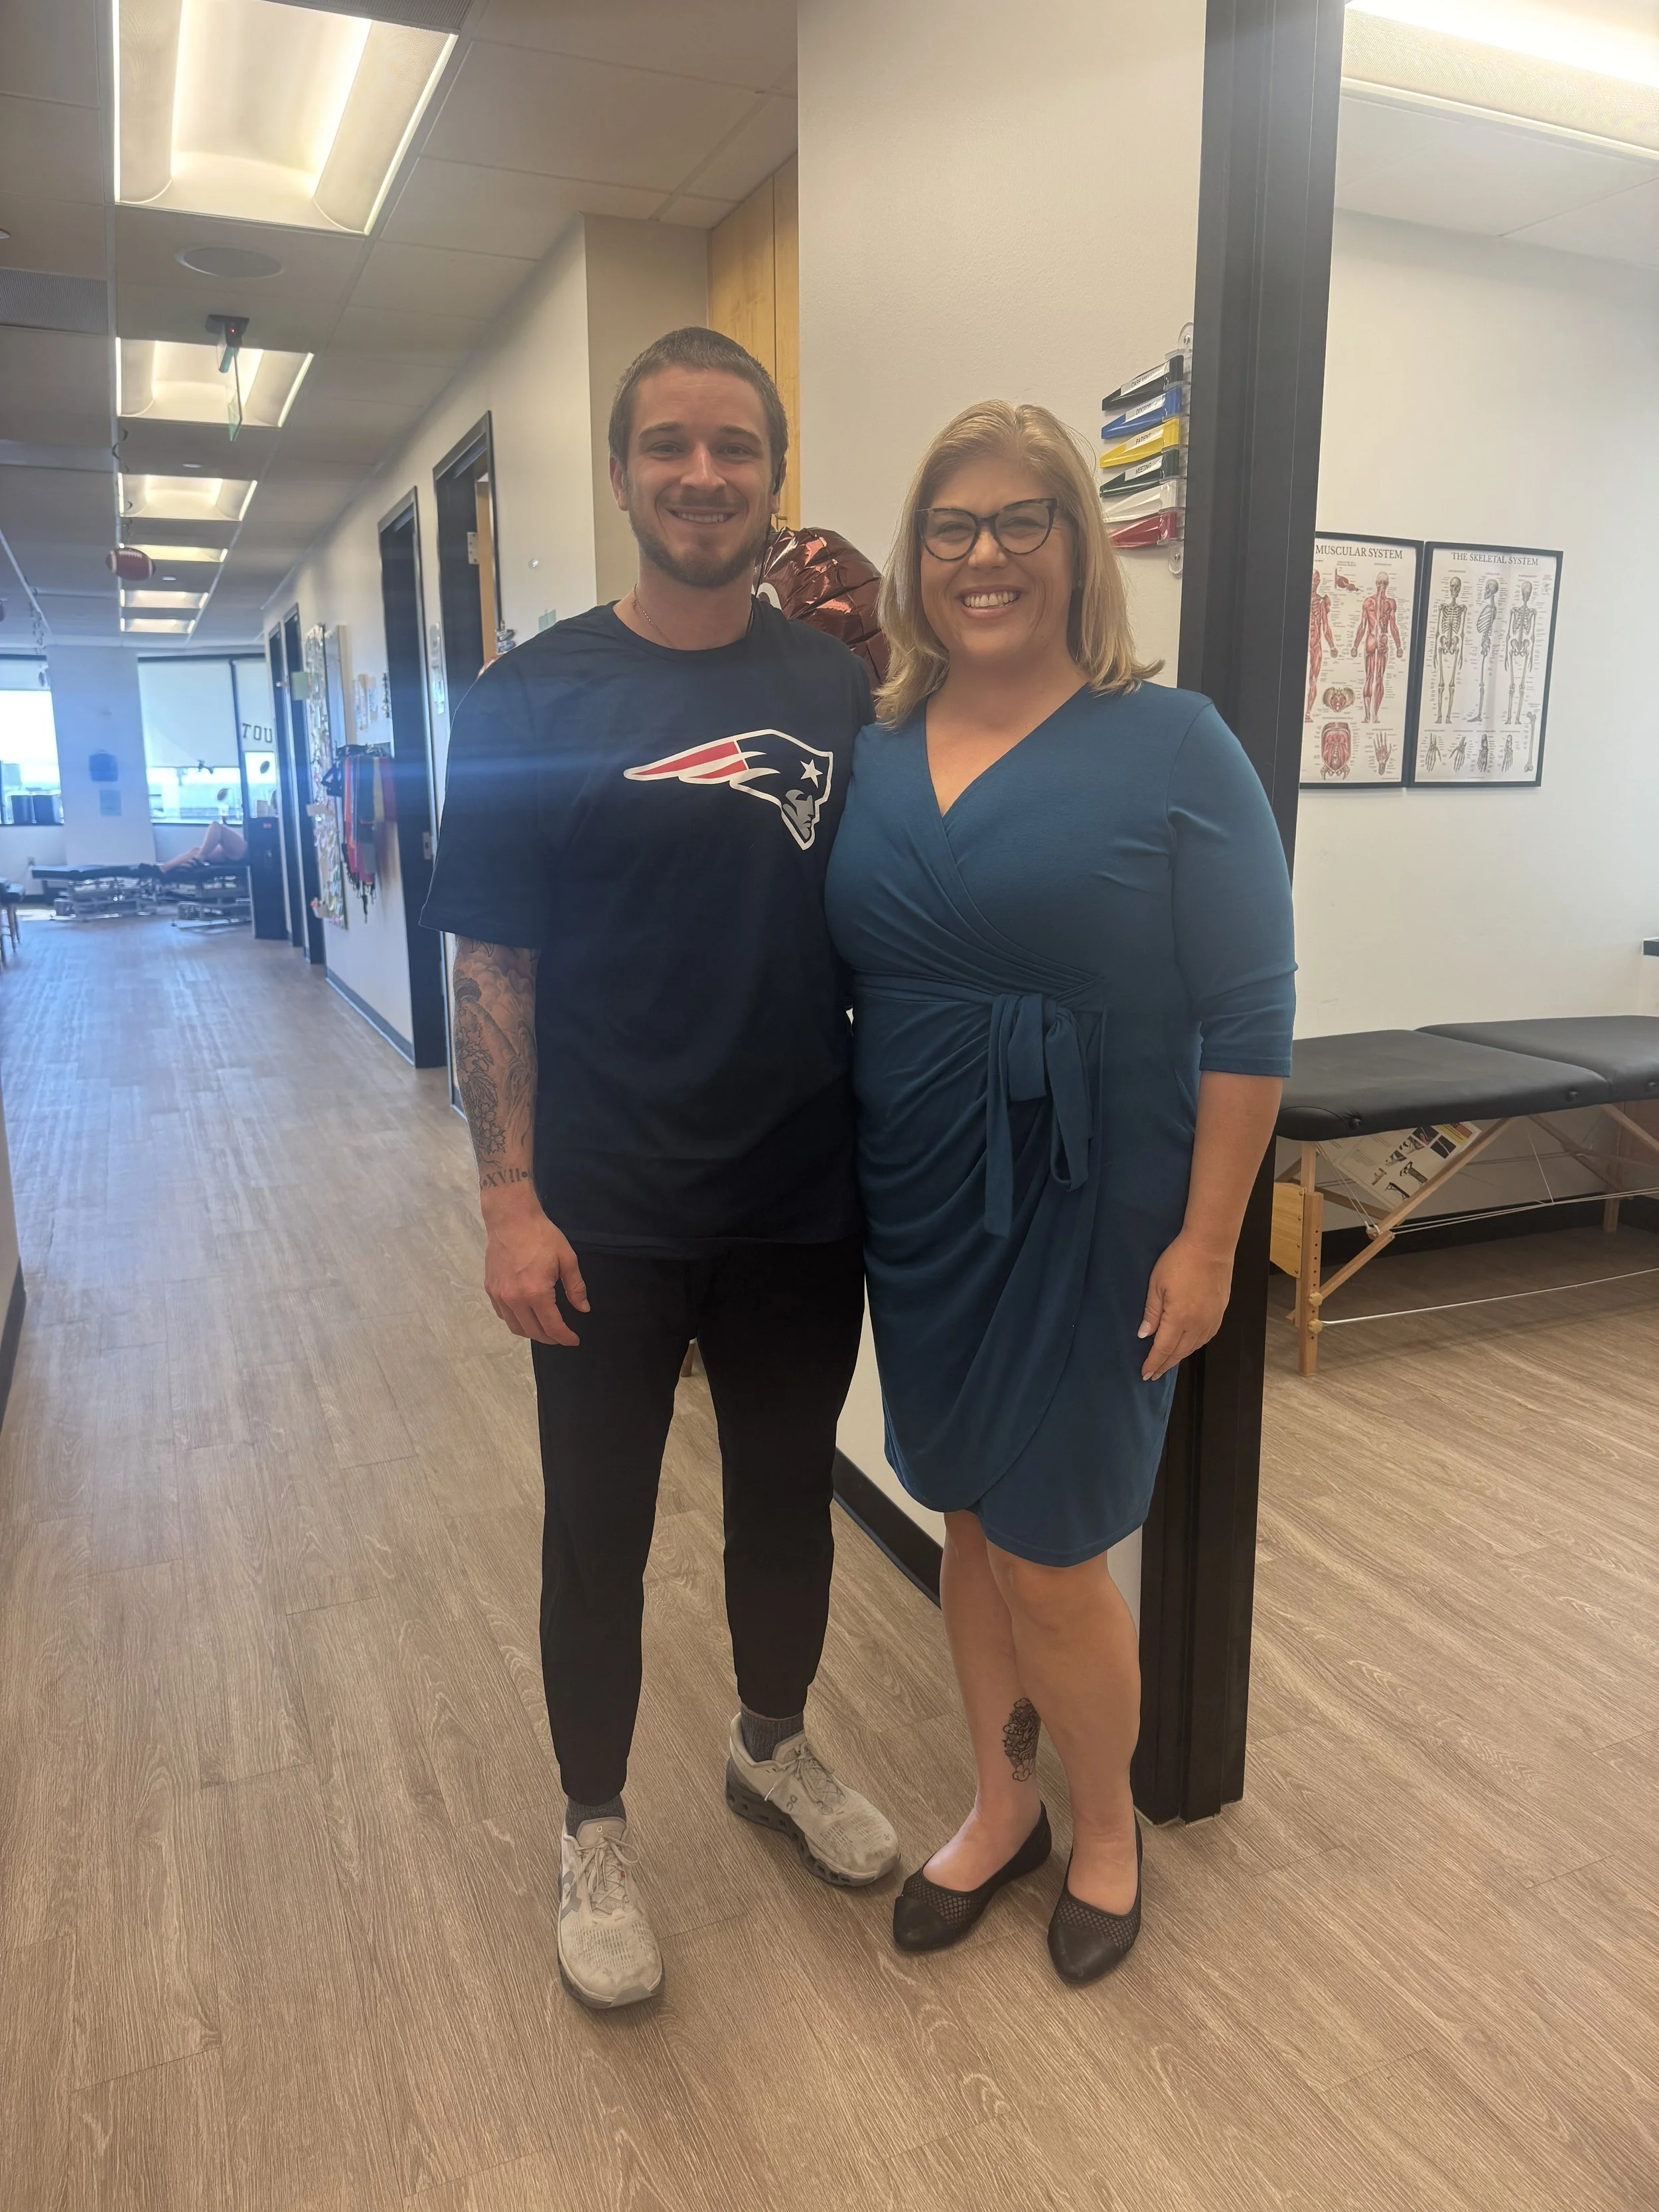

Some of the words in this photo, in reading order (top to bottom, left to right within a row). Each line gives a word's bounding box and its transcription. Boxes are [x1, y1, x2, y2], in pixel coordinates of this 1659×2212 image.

[1135, 433, 1151, 445] PATIENT
[1135, 463, 1151, 475] MEETING
[1315, 544, 1368, 557] MUSCULAR
[1368, 548, 1403, 559] SYSTEM
[1451, 552, 1468, 561] THE
[1469, 553, 1507, 563] SKELETAL
[1508, 556, 1538, 565] SYSTEM
[242, 722, 272, 743] TOU
